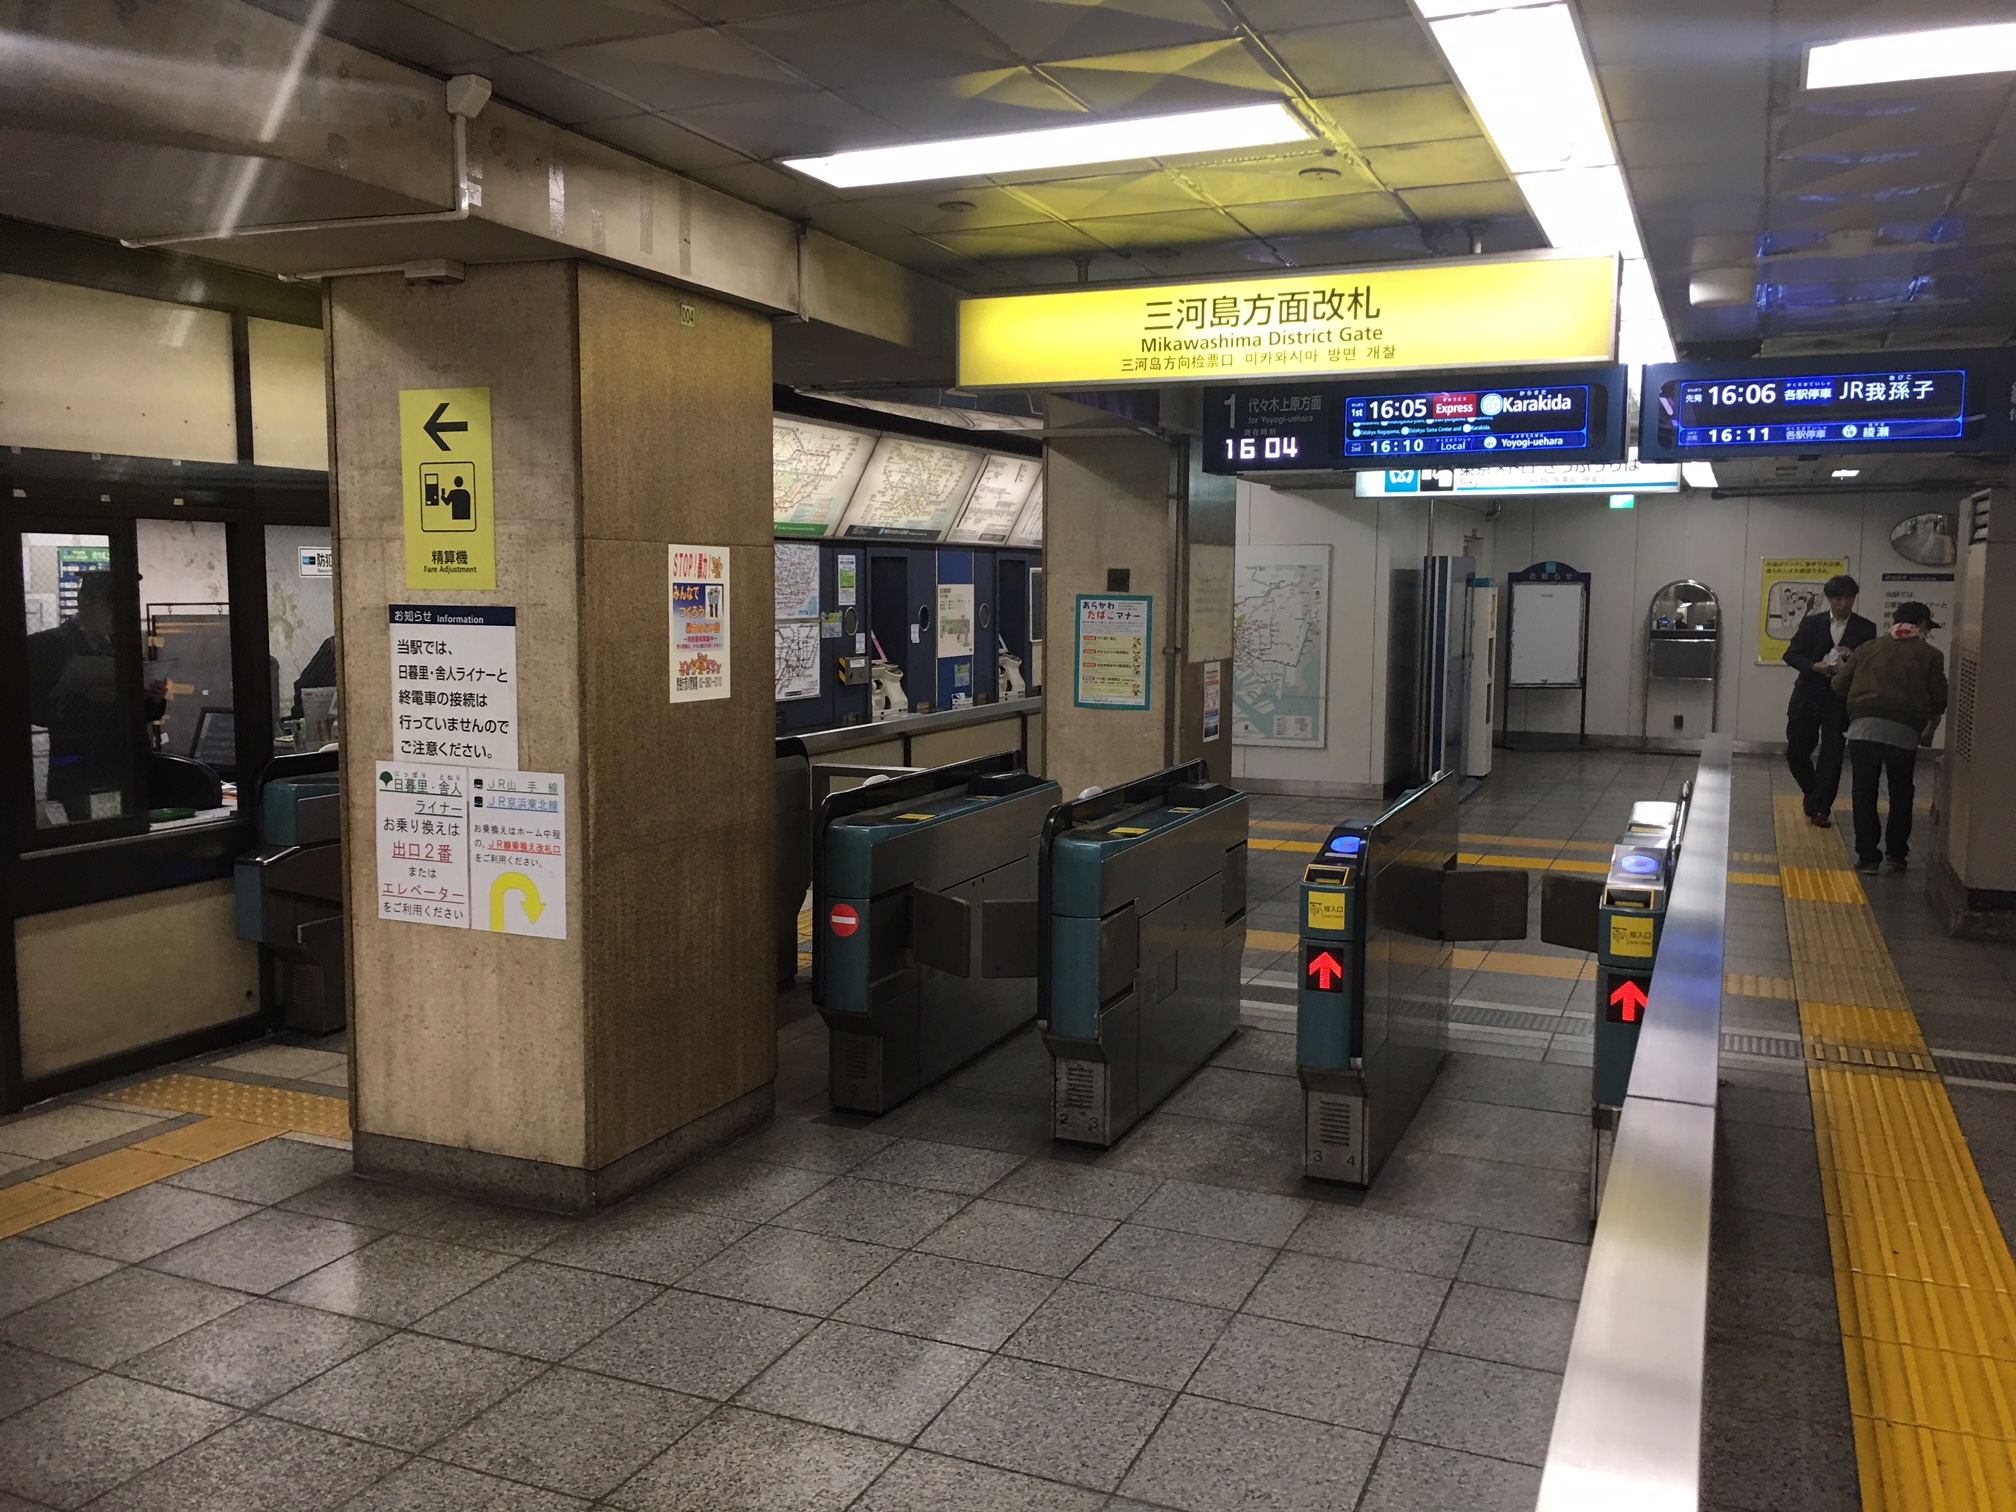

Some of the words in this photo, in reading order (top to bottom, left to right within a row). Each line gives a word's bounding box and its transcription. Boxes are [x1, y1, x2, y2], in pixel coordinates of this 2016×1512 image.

[1144, 285, 1381, 331] 三河島方面改札
[1141, 332, 1262, 353] Mikawashima
[1269, 328, 1333, 346] District
[1339, 326, 1383, 342] Gate
[1121, 353, 1234, 372] 三河岛方向检票口
[1245, 348, 1318, 365] 미카와시마
[1328, 346, 1357, 361] 방면
[1366, 344, 1397, 360] 개찰
[1685, 394, 1703, 403] 先発
[1708, 383, 1777, 405] 16:06
[1784, 388, 1832, 401] 各駅停車
[1839, 380, 1934, 402] JR我孫子
[1224, 393, 1237, 429] 1
[1248, 395, 1322, 413] 代々木上原方面
[1351, 408, 1363, 417] 1st
[1369, 398, 1428, 419] 16:05
[1436, 402, 1474, 416] Express
[1502, 394, 1571, 413] Karakida
[1248, 416, 1259, 424] for
[1261, 414, 1313, 425] Yoyogi-uehara
[1708, 427, 1770, 442] 16:11
[1785, 429, 1826, 440] 各駅停車
[1863, 426, 1890, 438] 綾瀬
[1370, 439, 1424, 453] 16:10
[1440, 441, 1465, 451] Local
[1501, 436, 1563, 449] Yoyogi-uehara
[431, 550, 468, 565] 精算機
[424, 565, 438, 573] Fare
[439, 564, 477, 574] Adjustment
[673, 585, 700, 600] みんなで
[679, 605, 705, 618] つくろう
[1083, 601, 1115, 610] あらかわ
[394, 610, 432, 622] お知らせ
[437, 614, 484, 624] Information
[1088, 610, 1140, 620] たばこマナー
[397, 639, 453, 655] 当駅では、
[398, 665, 508, 683] 日暮里・舎人ライナーと
[399, 690, 488, 708] 終電車の接続は
[399, 714, 509, 734] 行っていませんので
[401, 740, 492, 759] ご注意ください。
[439, 773, 461, 781] とねり
[415, 800, 463, 815] ライナー
[488, 796, 558, 812] JR京浜東北線
[383, 817, 460, 836] お乗り換えは
[474, 824, 561, 840] お乗換えはホーム中程
[393, 840, 452, 863] 出口2番
[475, 853, 542, 868] をご利用ください。
[408, 866, 437, 879] または
[382, 883, 464, 900] エレベーター
[384, 901, 464, 920] をご利用ください
[1059, 1112, 1069, 1125] 2
[1090, 1117, 1099, 1129] 3
[1313, 1149, 1323, 1162] 3
[1346, 1155, 1355, 1167] 4
